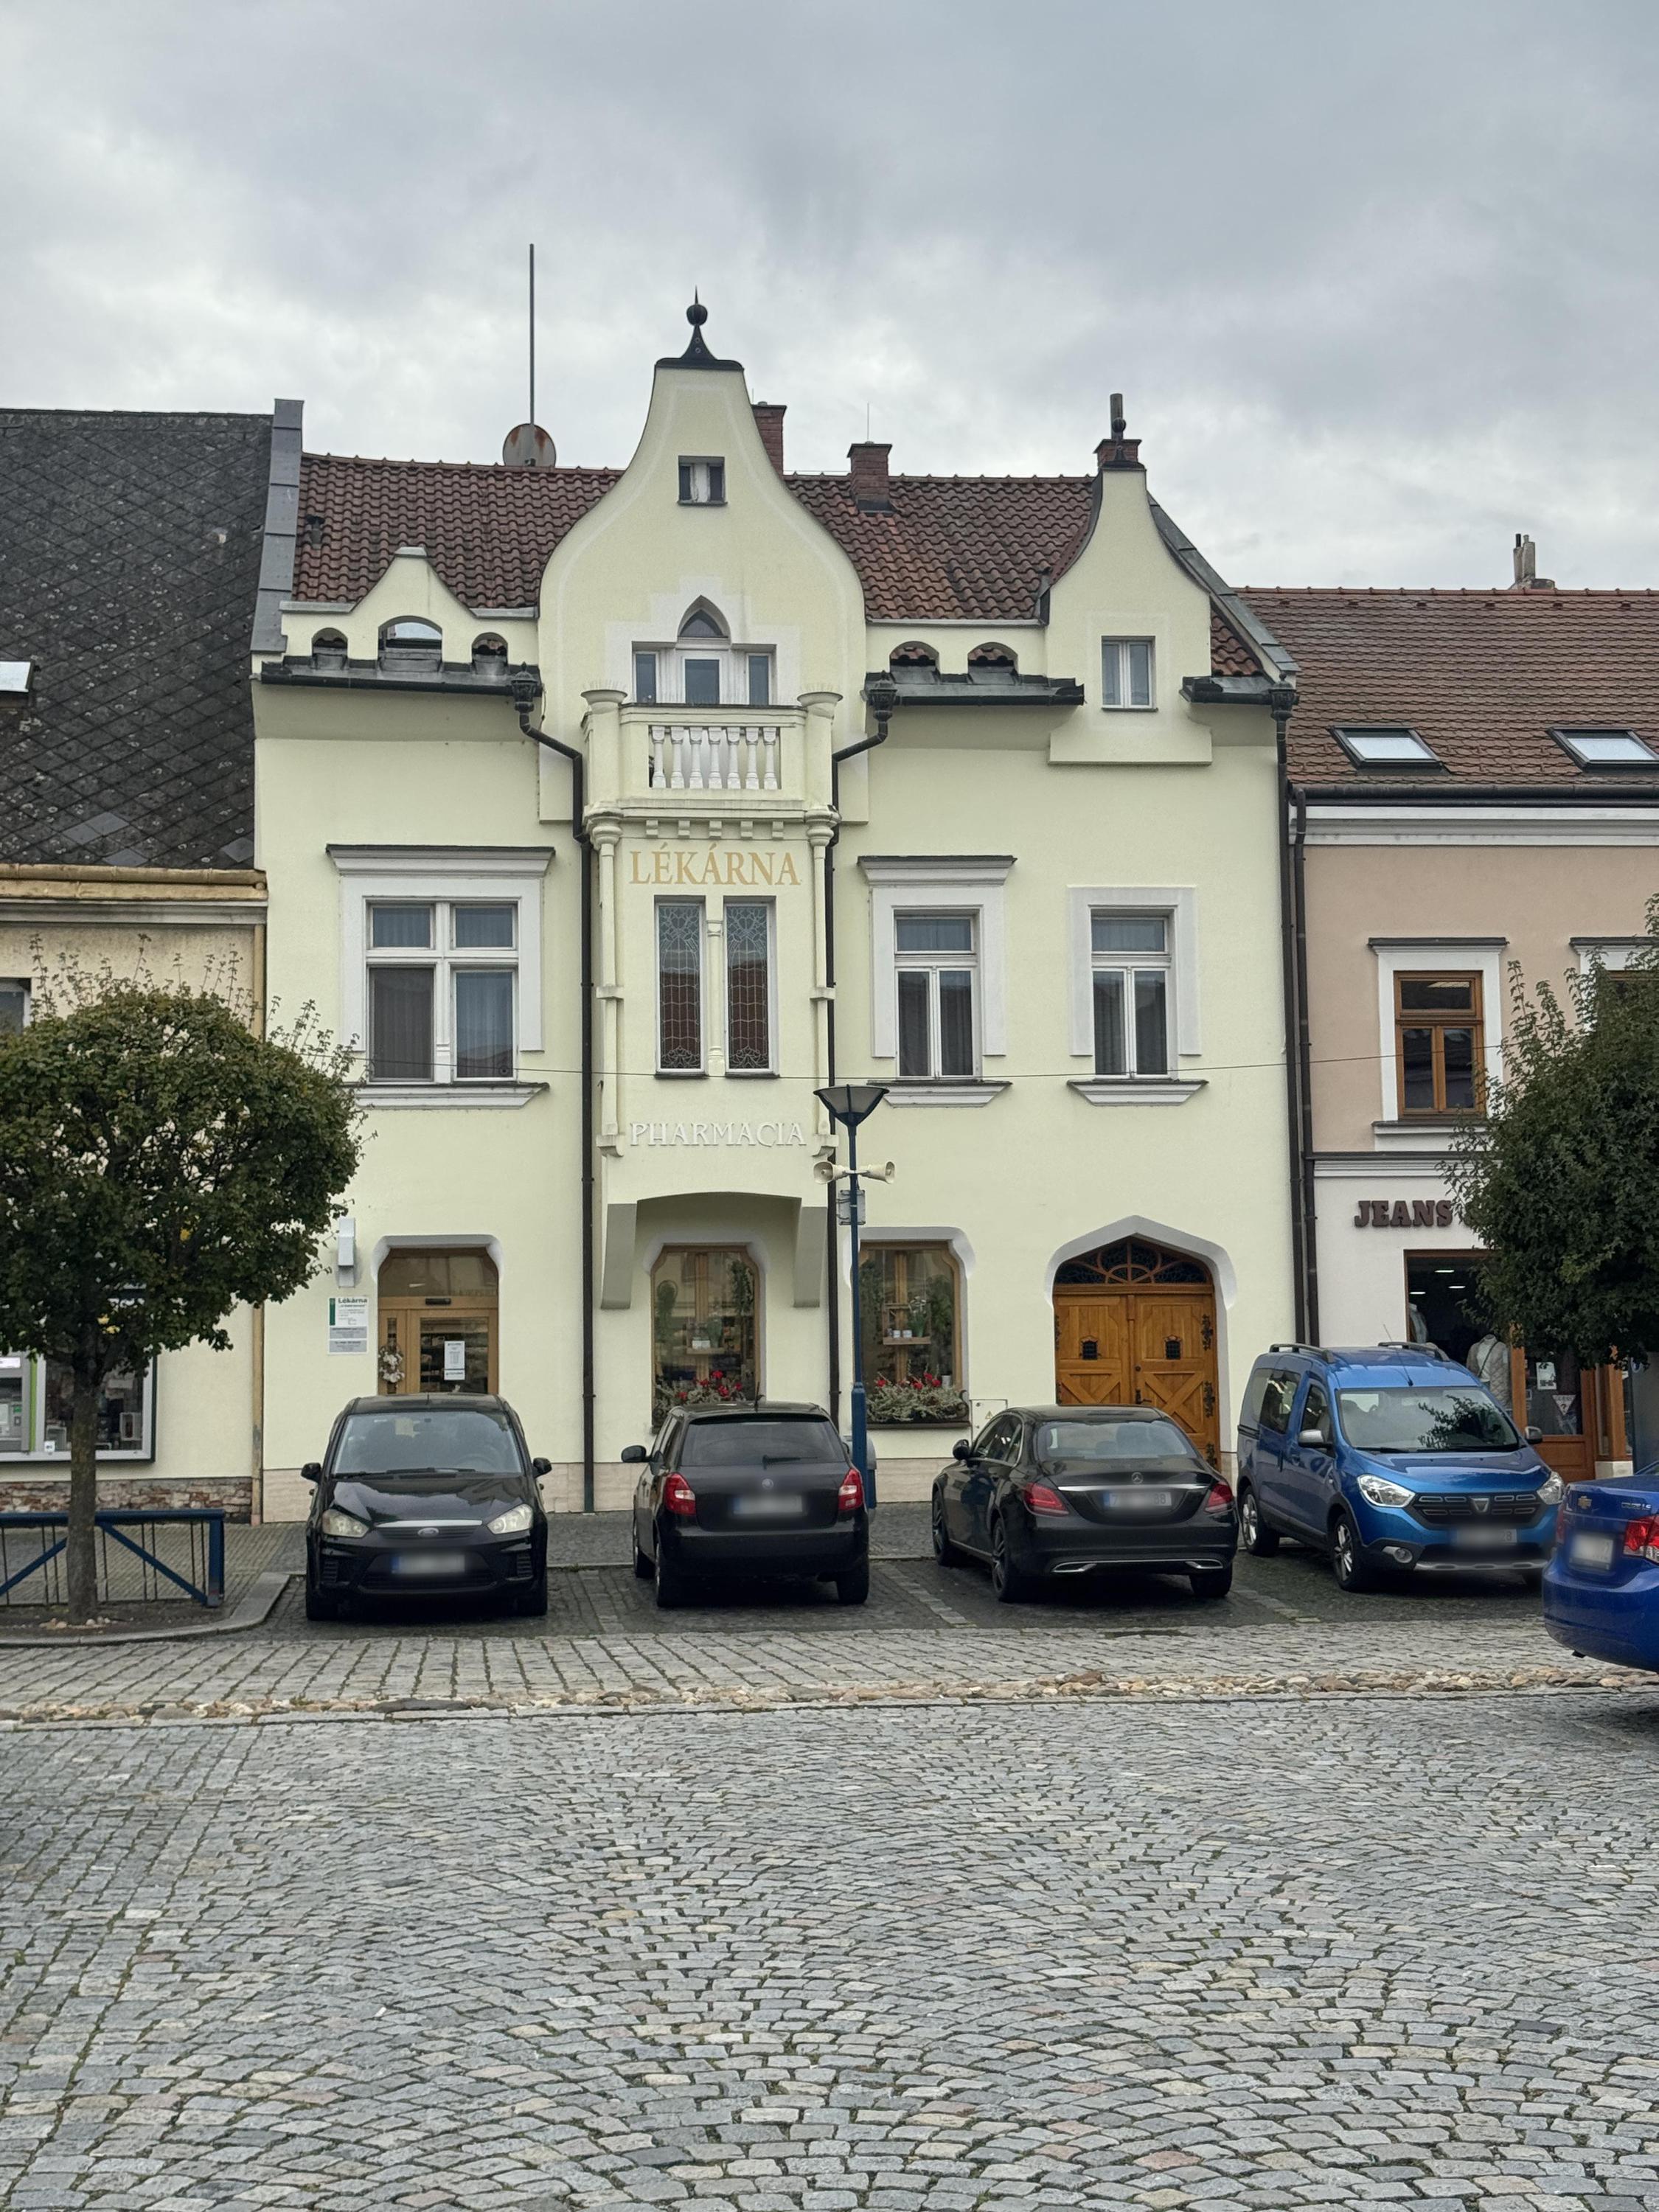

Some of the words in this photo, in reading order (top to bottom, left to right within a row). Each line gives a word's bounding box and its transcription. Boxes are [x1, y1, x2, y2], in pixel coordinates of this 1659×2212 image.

[629, 842, 801, 886] LÉKÁRNA
[630, 1122, 807, 1147] PHARMACIA
[1354, 1200, 1453, 1228] JEANS
